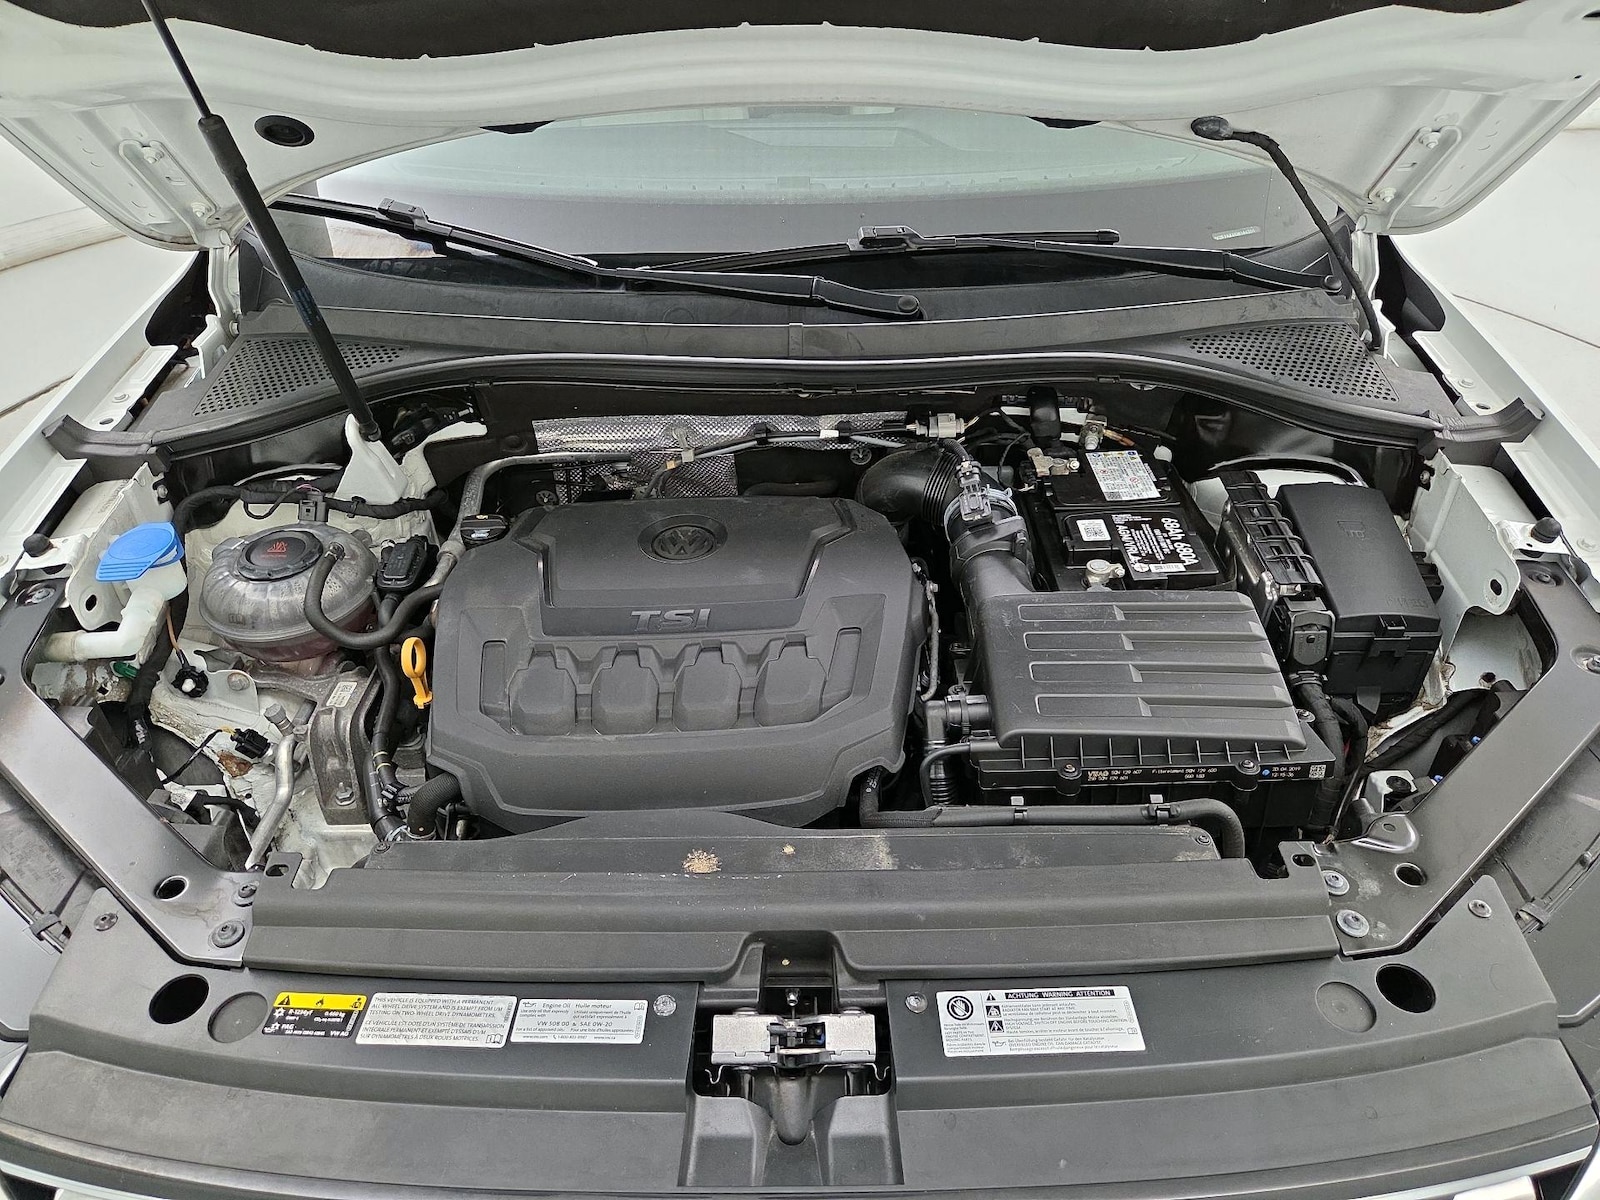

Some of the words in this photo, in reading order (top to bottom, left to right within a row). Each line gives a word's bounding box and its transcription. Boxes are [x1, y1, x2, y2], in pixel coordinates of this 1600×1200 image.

[1161, 518, 1186, 540] 68Ah
[1174, 542, 1199, 566] 680A
[630, 608, 710, 632] TSI
